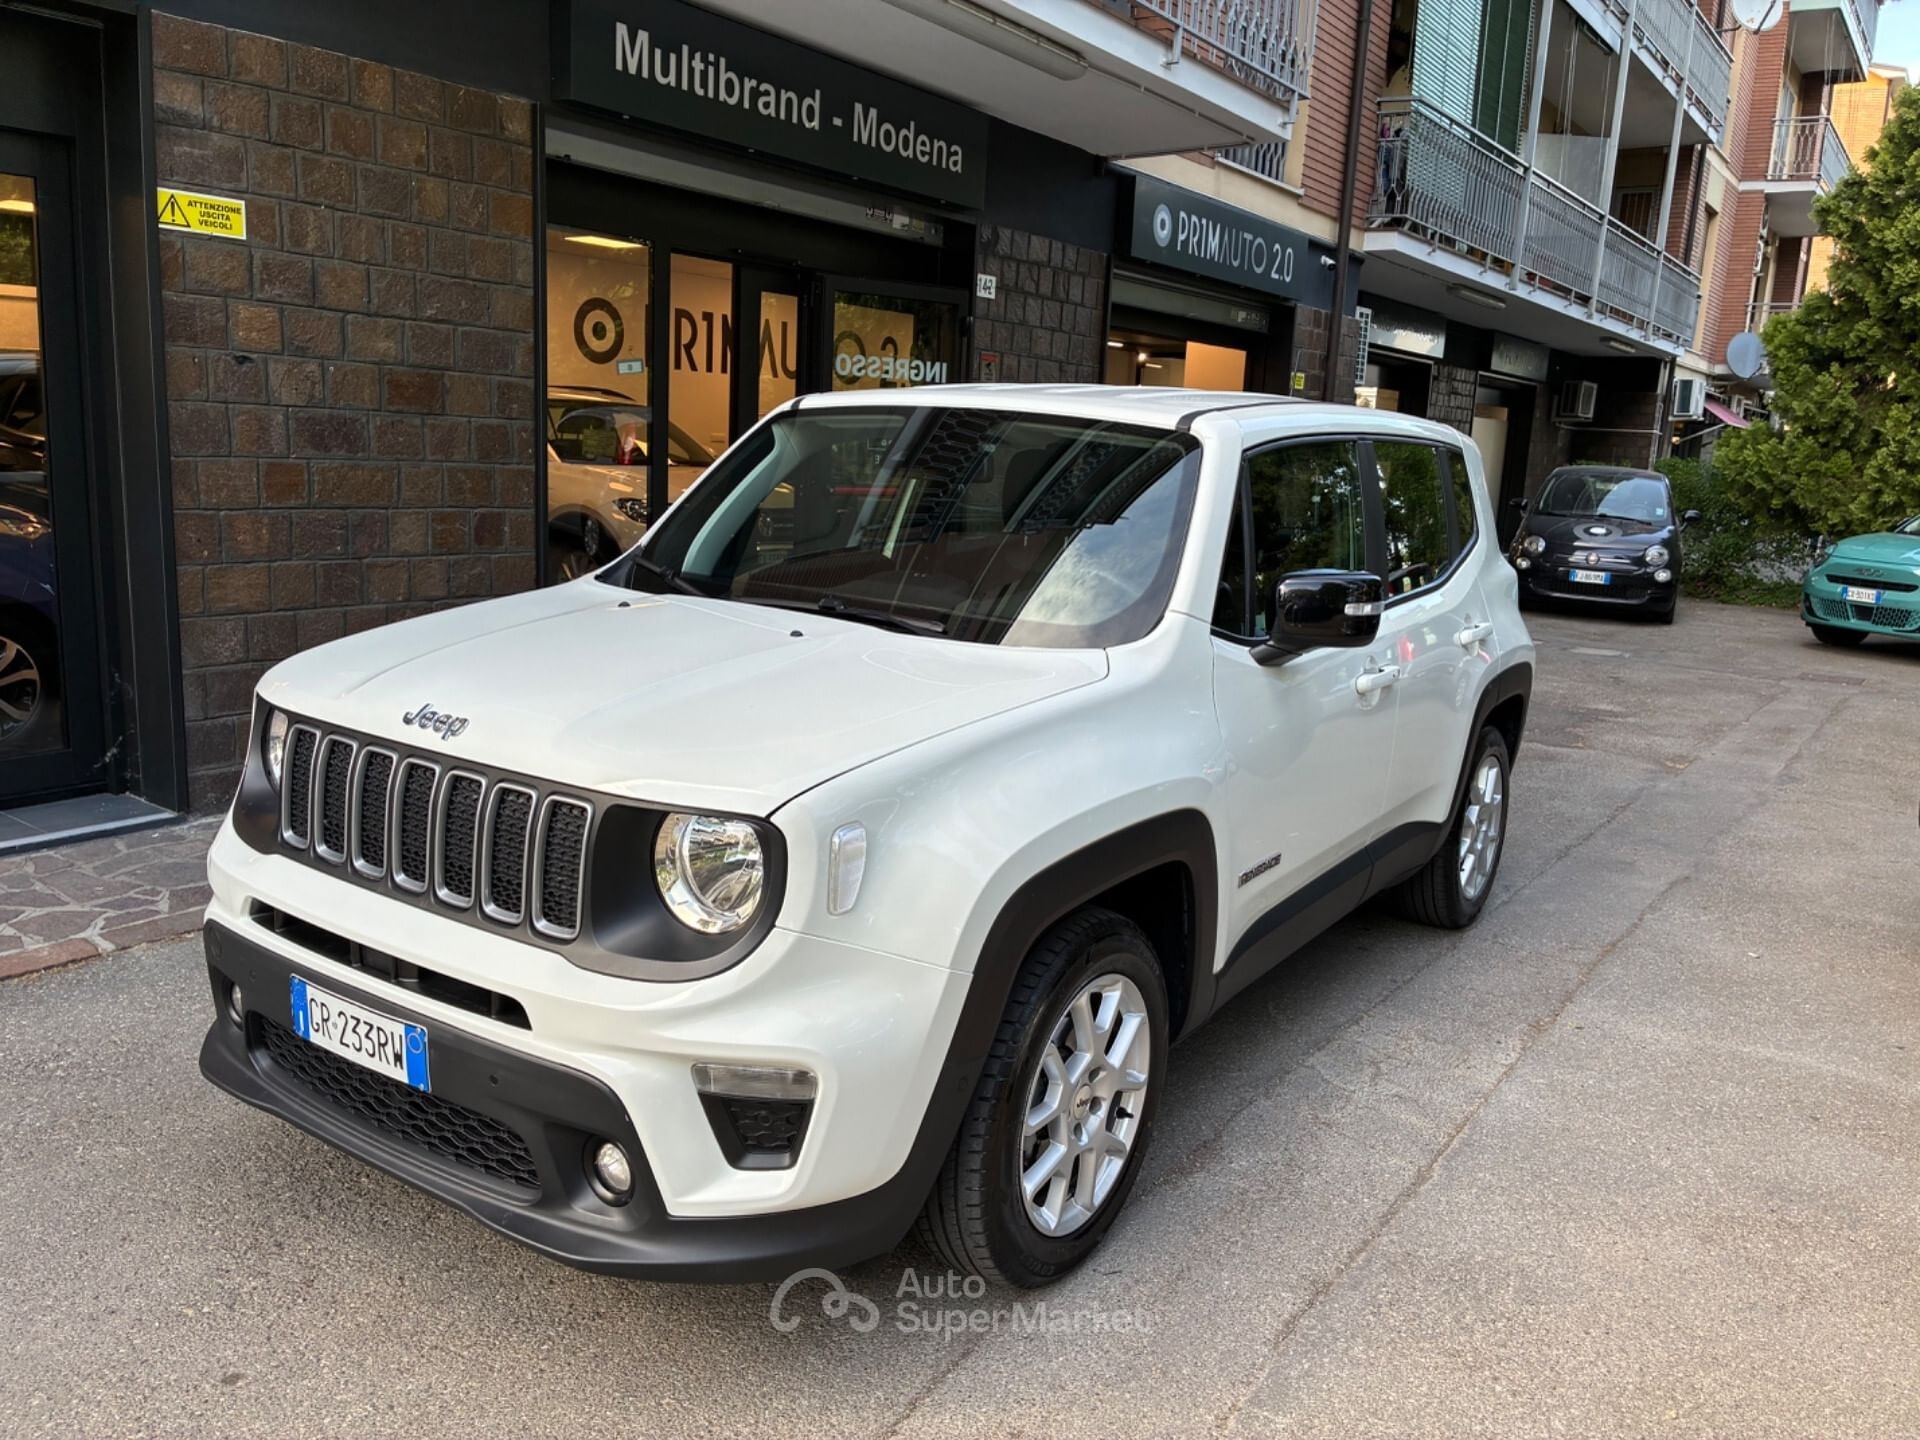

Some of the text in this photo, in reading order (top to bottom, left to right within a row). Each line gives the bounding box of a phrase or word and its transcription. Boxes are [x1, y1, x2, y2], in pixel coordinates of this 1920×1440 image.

[614, 21, 821, 131] Multibrand
[852, 102, 963, 174] Modena
[187, 200, 242, 215] ATTENZIONE
[199, 210, 231, 222] USCITA
[198, 219, 232, 231] VEICOLI
[1271, 243, 1294, 283] 2.0
[978, 276, 993, 296] 142
[403, 703, 470, 741] Jeep
